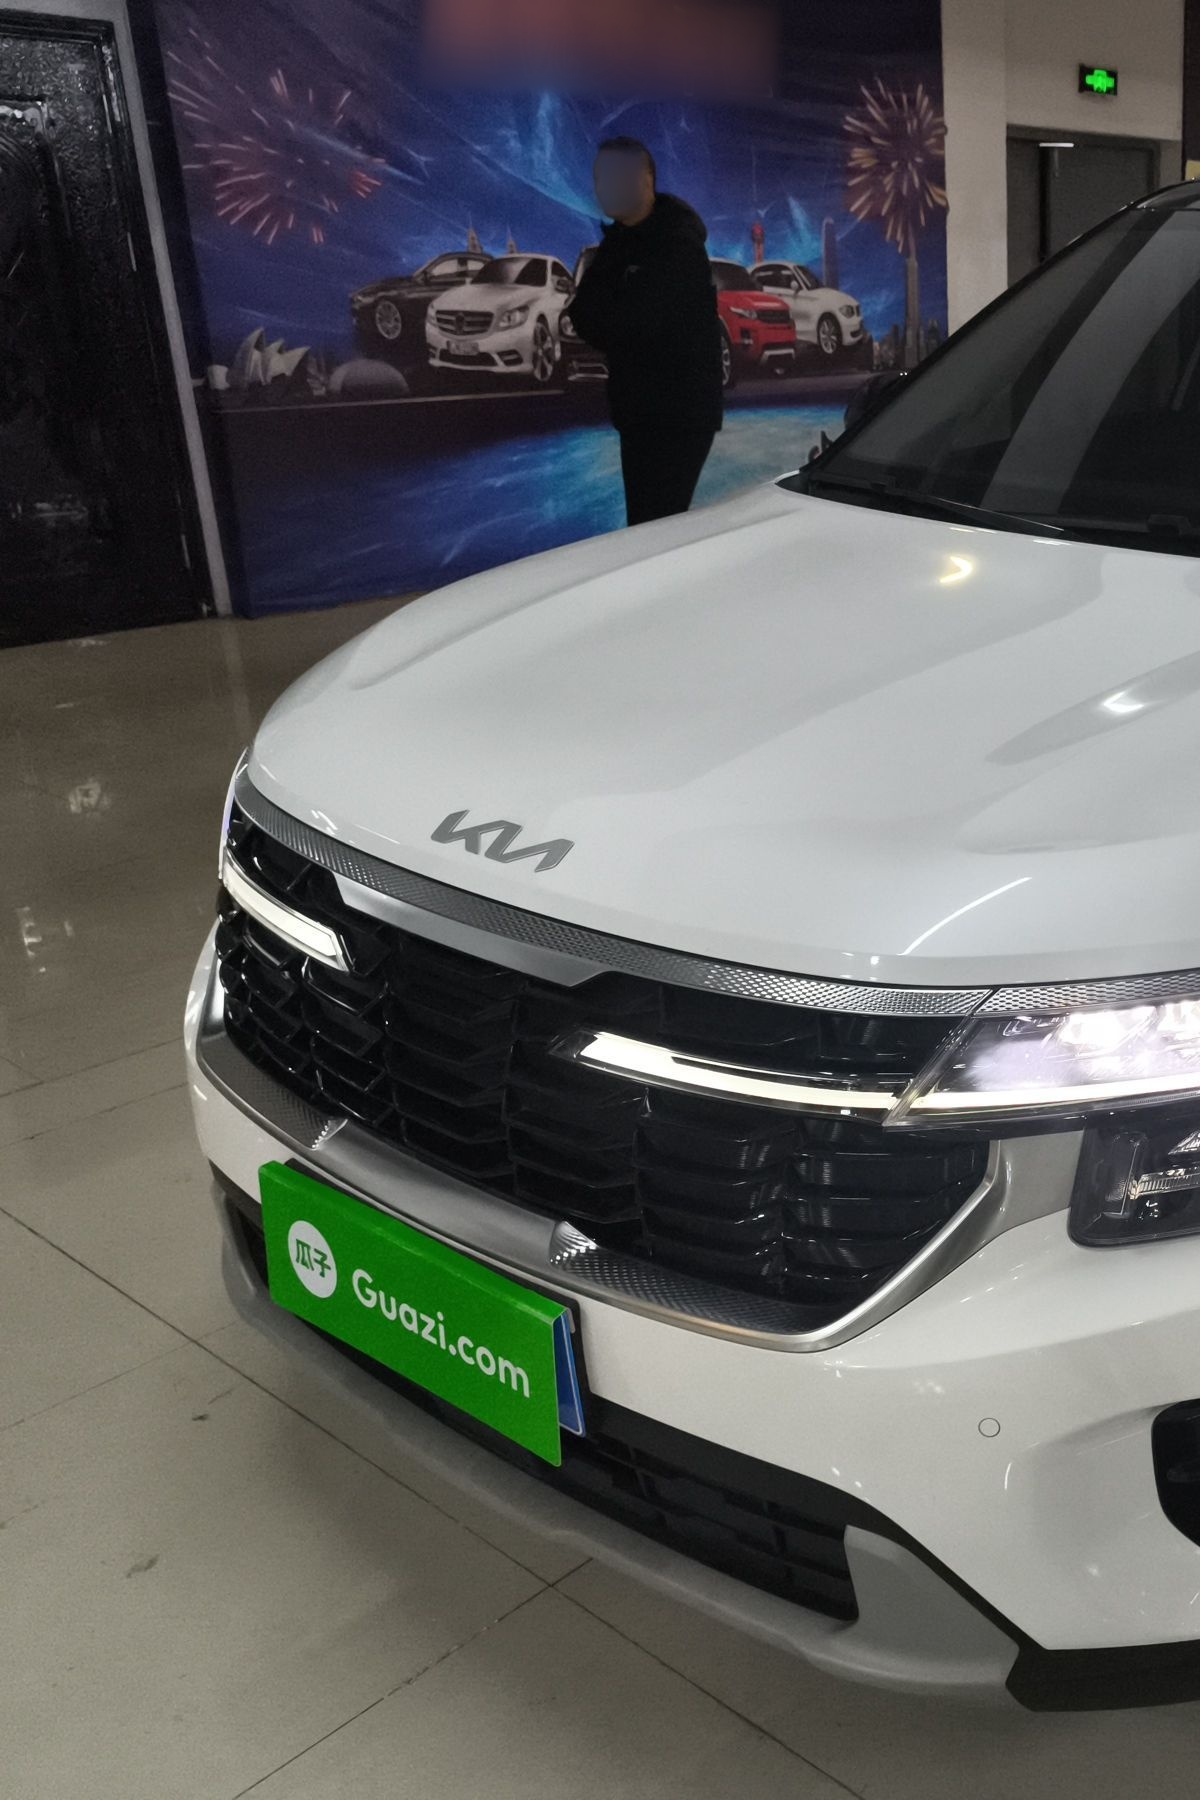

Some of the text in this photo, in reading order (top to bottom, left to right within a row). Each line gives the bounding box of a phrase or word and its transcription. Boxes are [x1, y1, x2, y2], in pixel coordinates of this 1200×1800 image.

[430, 809, 576, 873] KIA
[295, 1238, 332, 1278] 瓜子
[351, 1268, 531, 1399] Guazi.com
